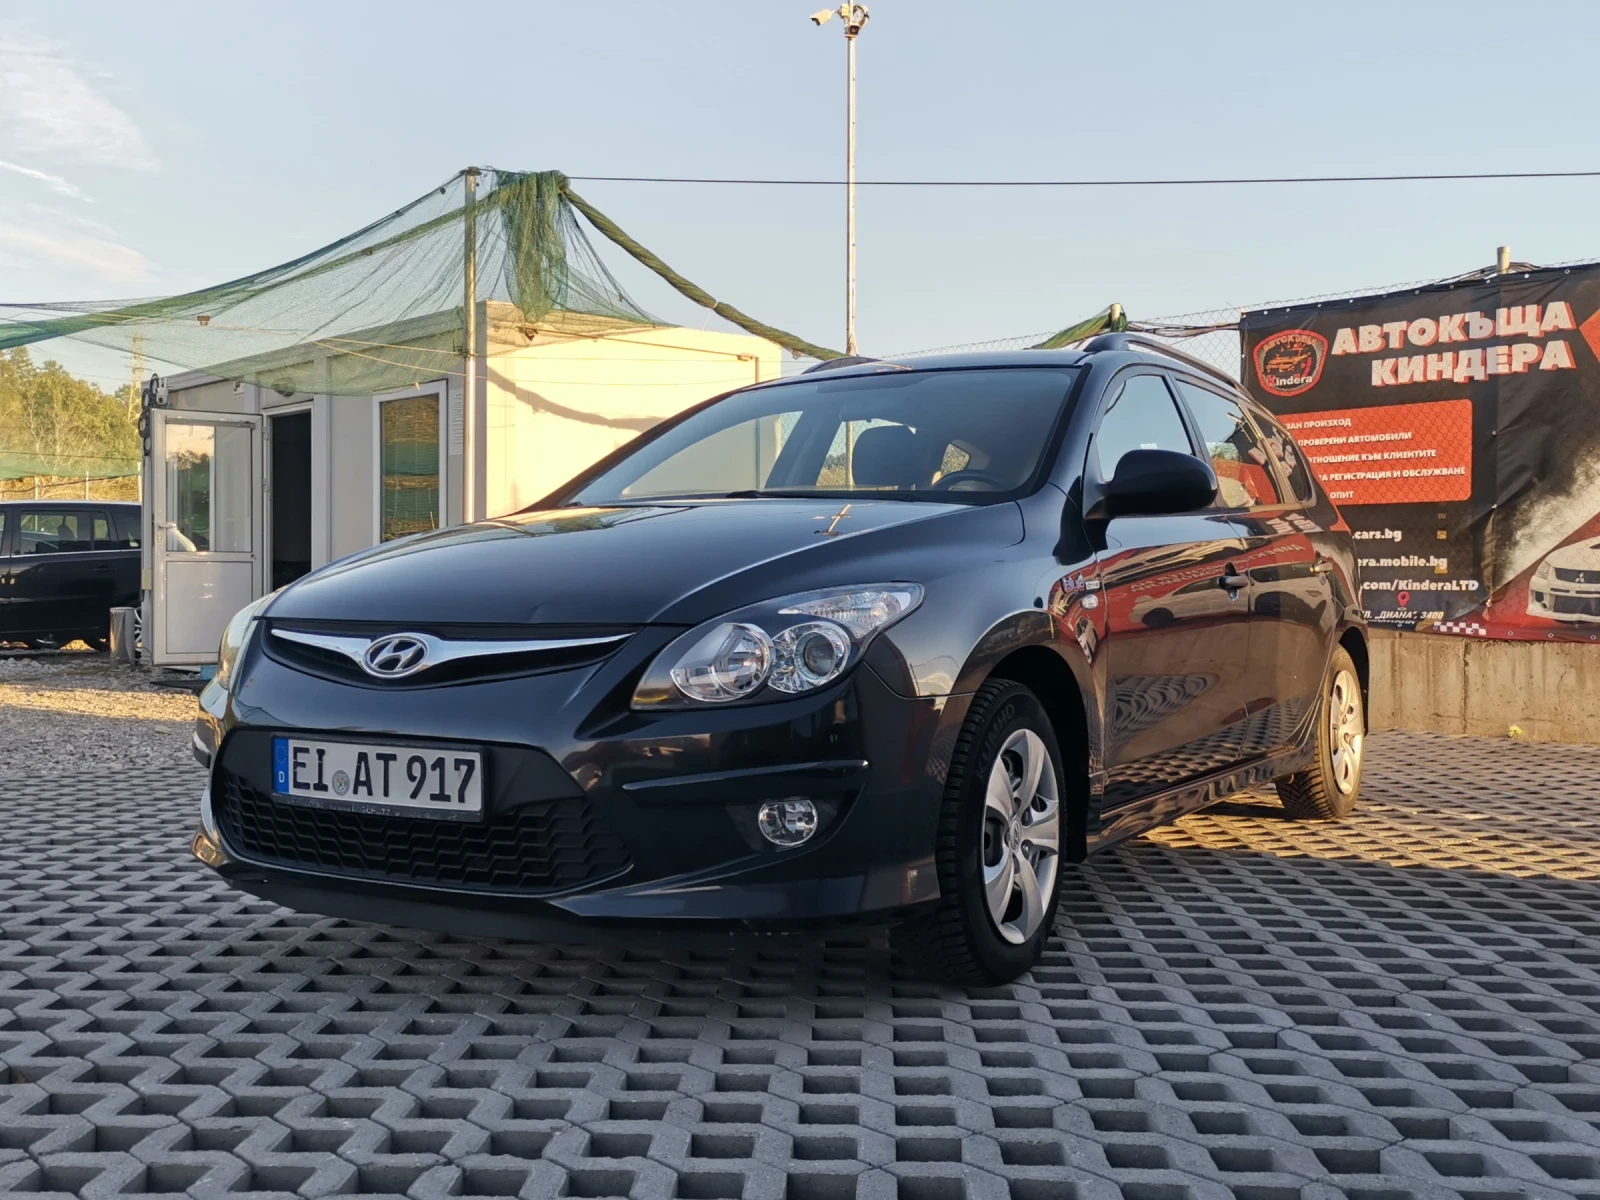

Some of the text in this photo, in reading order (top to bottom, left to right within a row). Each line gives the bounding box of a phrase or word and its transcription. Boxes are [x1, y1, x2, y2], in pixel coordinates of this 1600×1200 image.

[1331, 301, 1577, 355] АВТОКЪЩА
[1371, 340, 1577, 387] КИНДЕРА
[1266, 375, 1313, 387] Kindera
[1304, 418, 1352, 428] ПРОИЗХОД
[1348, 432, 1412, 443] АВТОМОБИЛИ
[1362, 453, 1382, 461] КЪМ
[1384, 449, 1437, 459] КЛИЕНТИТЕ
[1330, 471, 1391, 480] РЕГИСТРАЦИЯ
[1402, 467, 1465, 477] ОБСЛУЖВАНЕ
[1330, 491, 1354, 499] ОПИТ
[1420, 611, 1444, 619] 3400
[279, 771, 285, 783] D
[293, 747, 476, 804] EI AT 917
